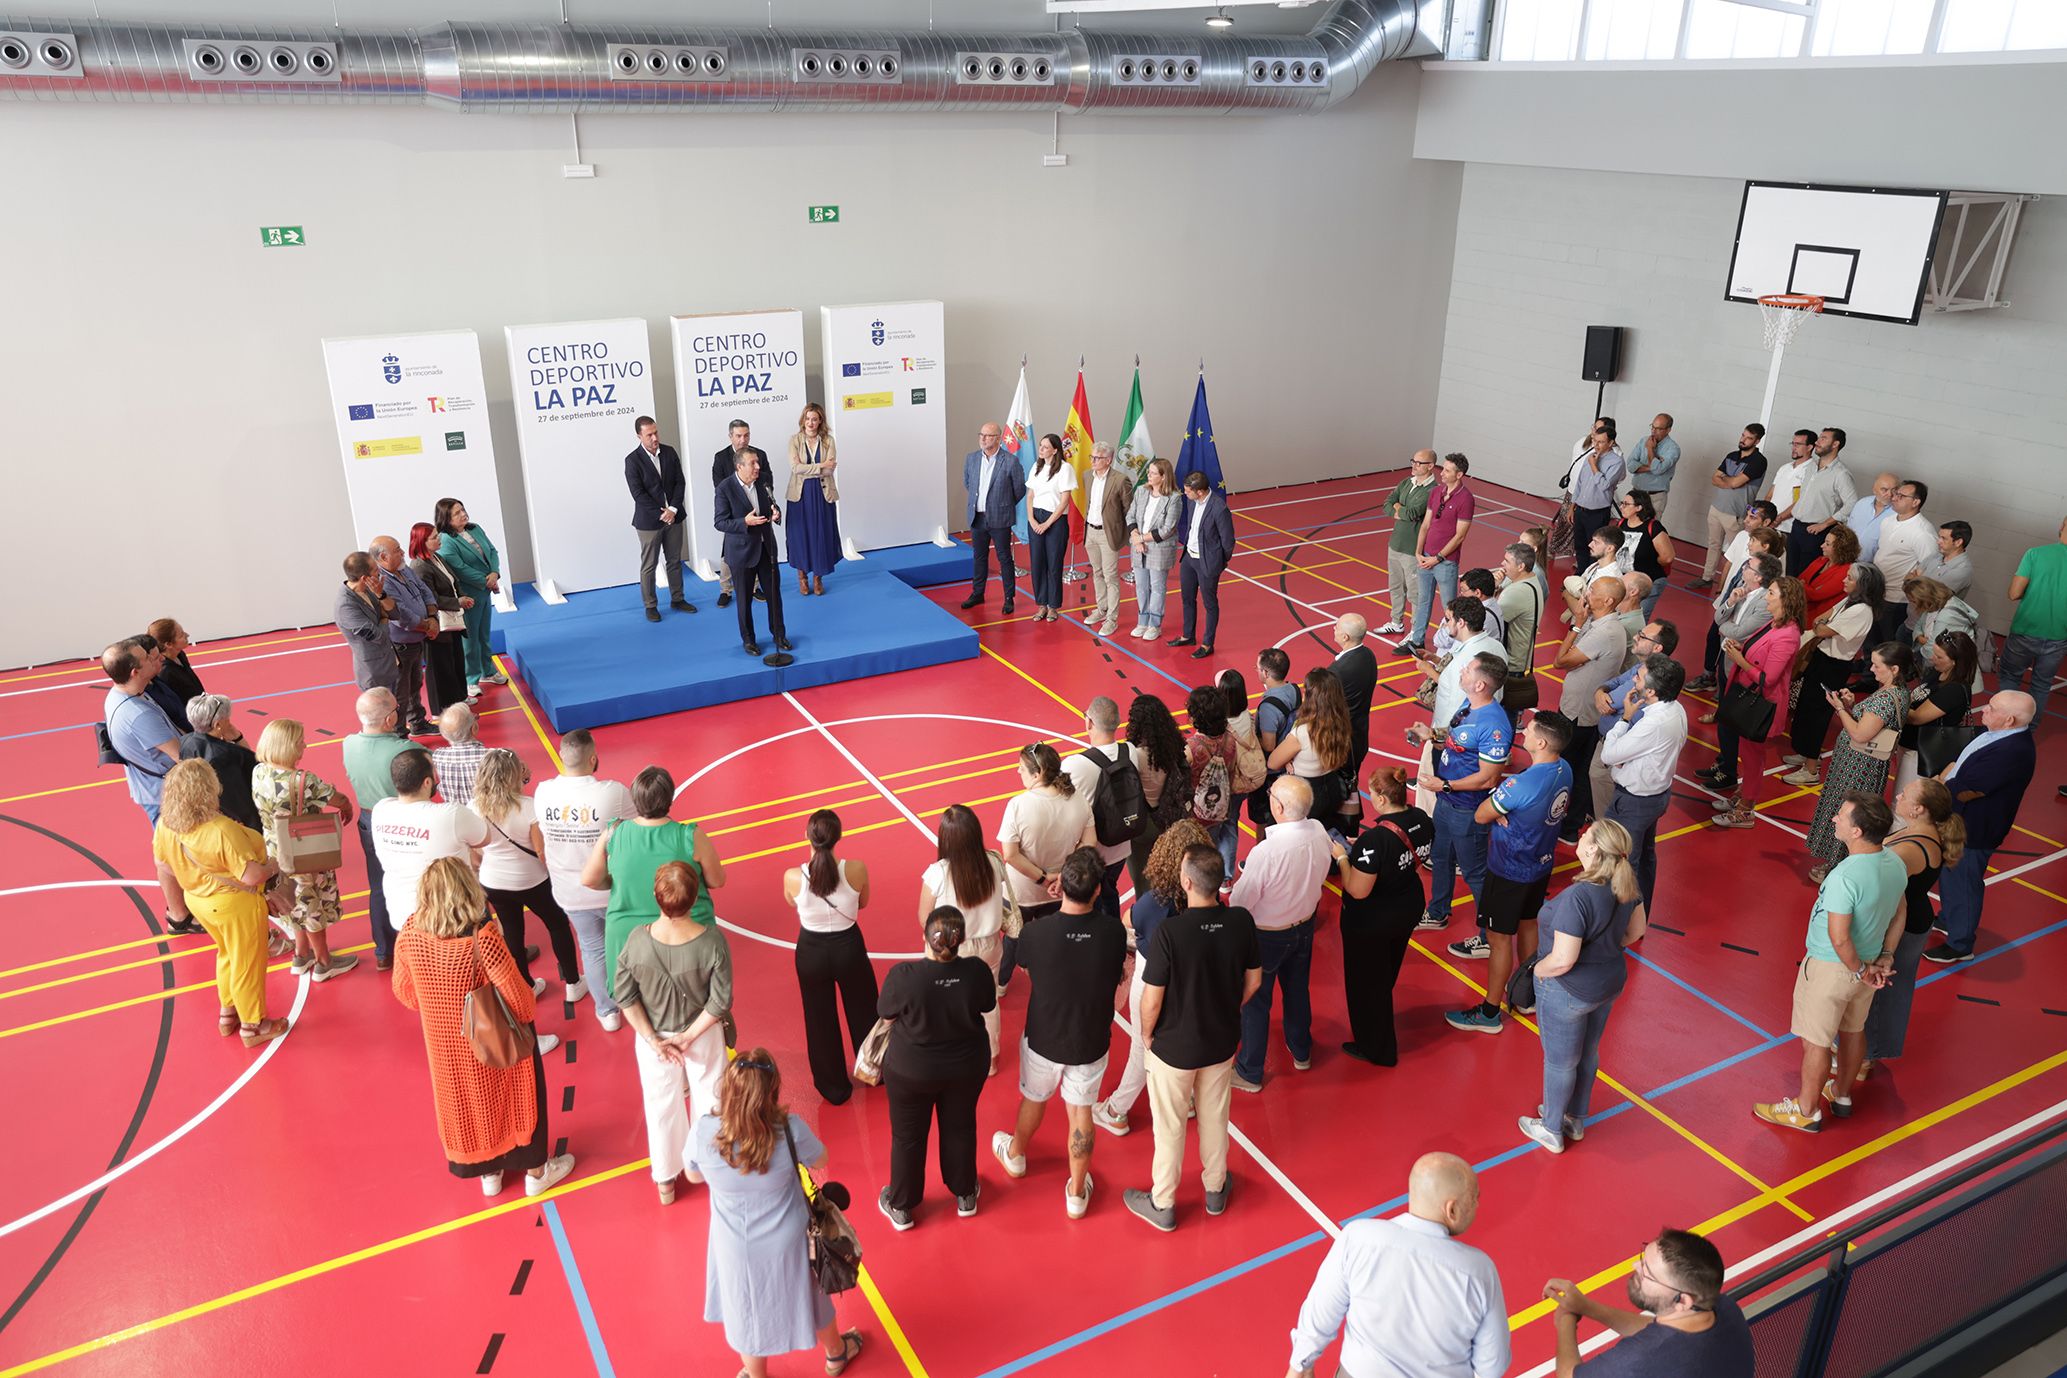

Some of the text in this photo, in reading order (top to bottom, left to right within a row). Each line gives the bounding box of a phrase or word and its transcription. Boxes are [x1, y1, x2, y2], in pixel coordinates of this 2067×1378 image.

[527, 342, 608, 364] CENTRO
[693, 332, 766, 353] CENTRO
[695, 350, 798, 374] DEPORTIVO
[530, 361, 643, 386] DEPORTIVO
[697, 372, 773, 397] LA PAZ
[534, 384, 617, 411] LA PAZ
[700, 401, 708, 409] 27
[721, 396, 760, 407] septiembre
[771, 394, 788, 402] 2024
[538, 406, 635, 423] 27 de septiembre de 2024
[376, 824, 430, 840] PIZZERIA
